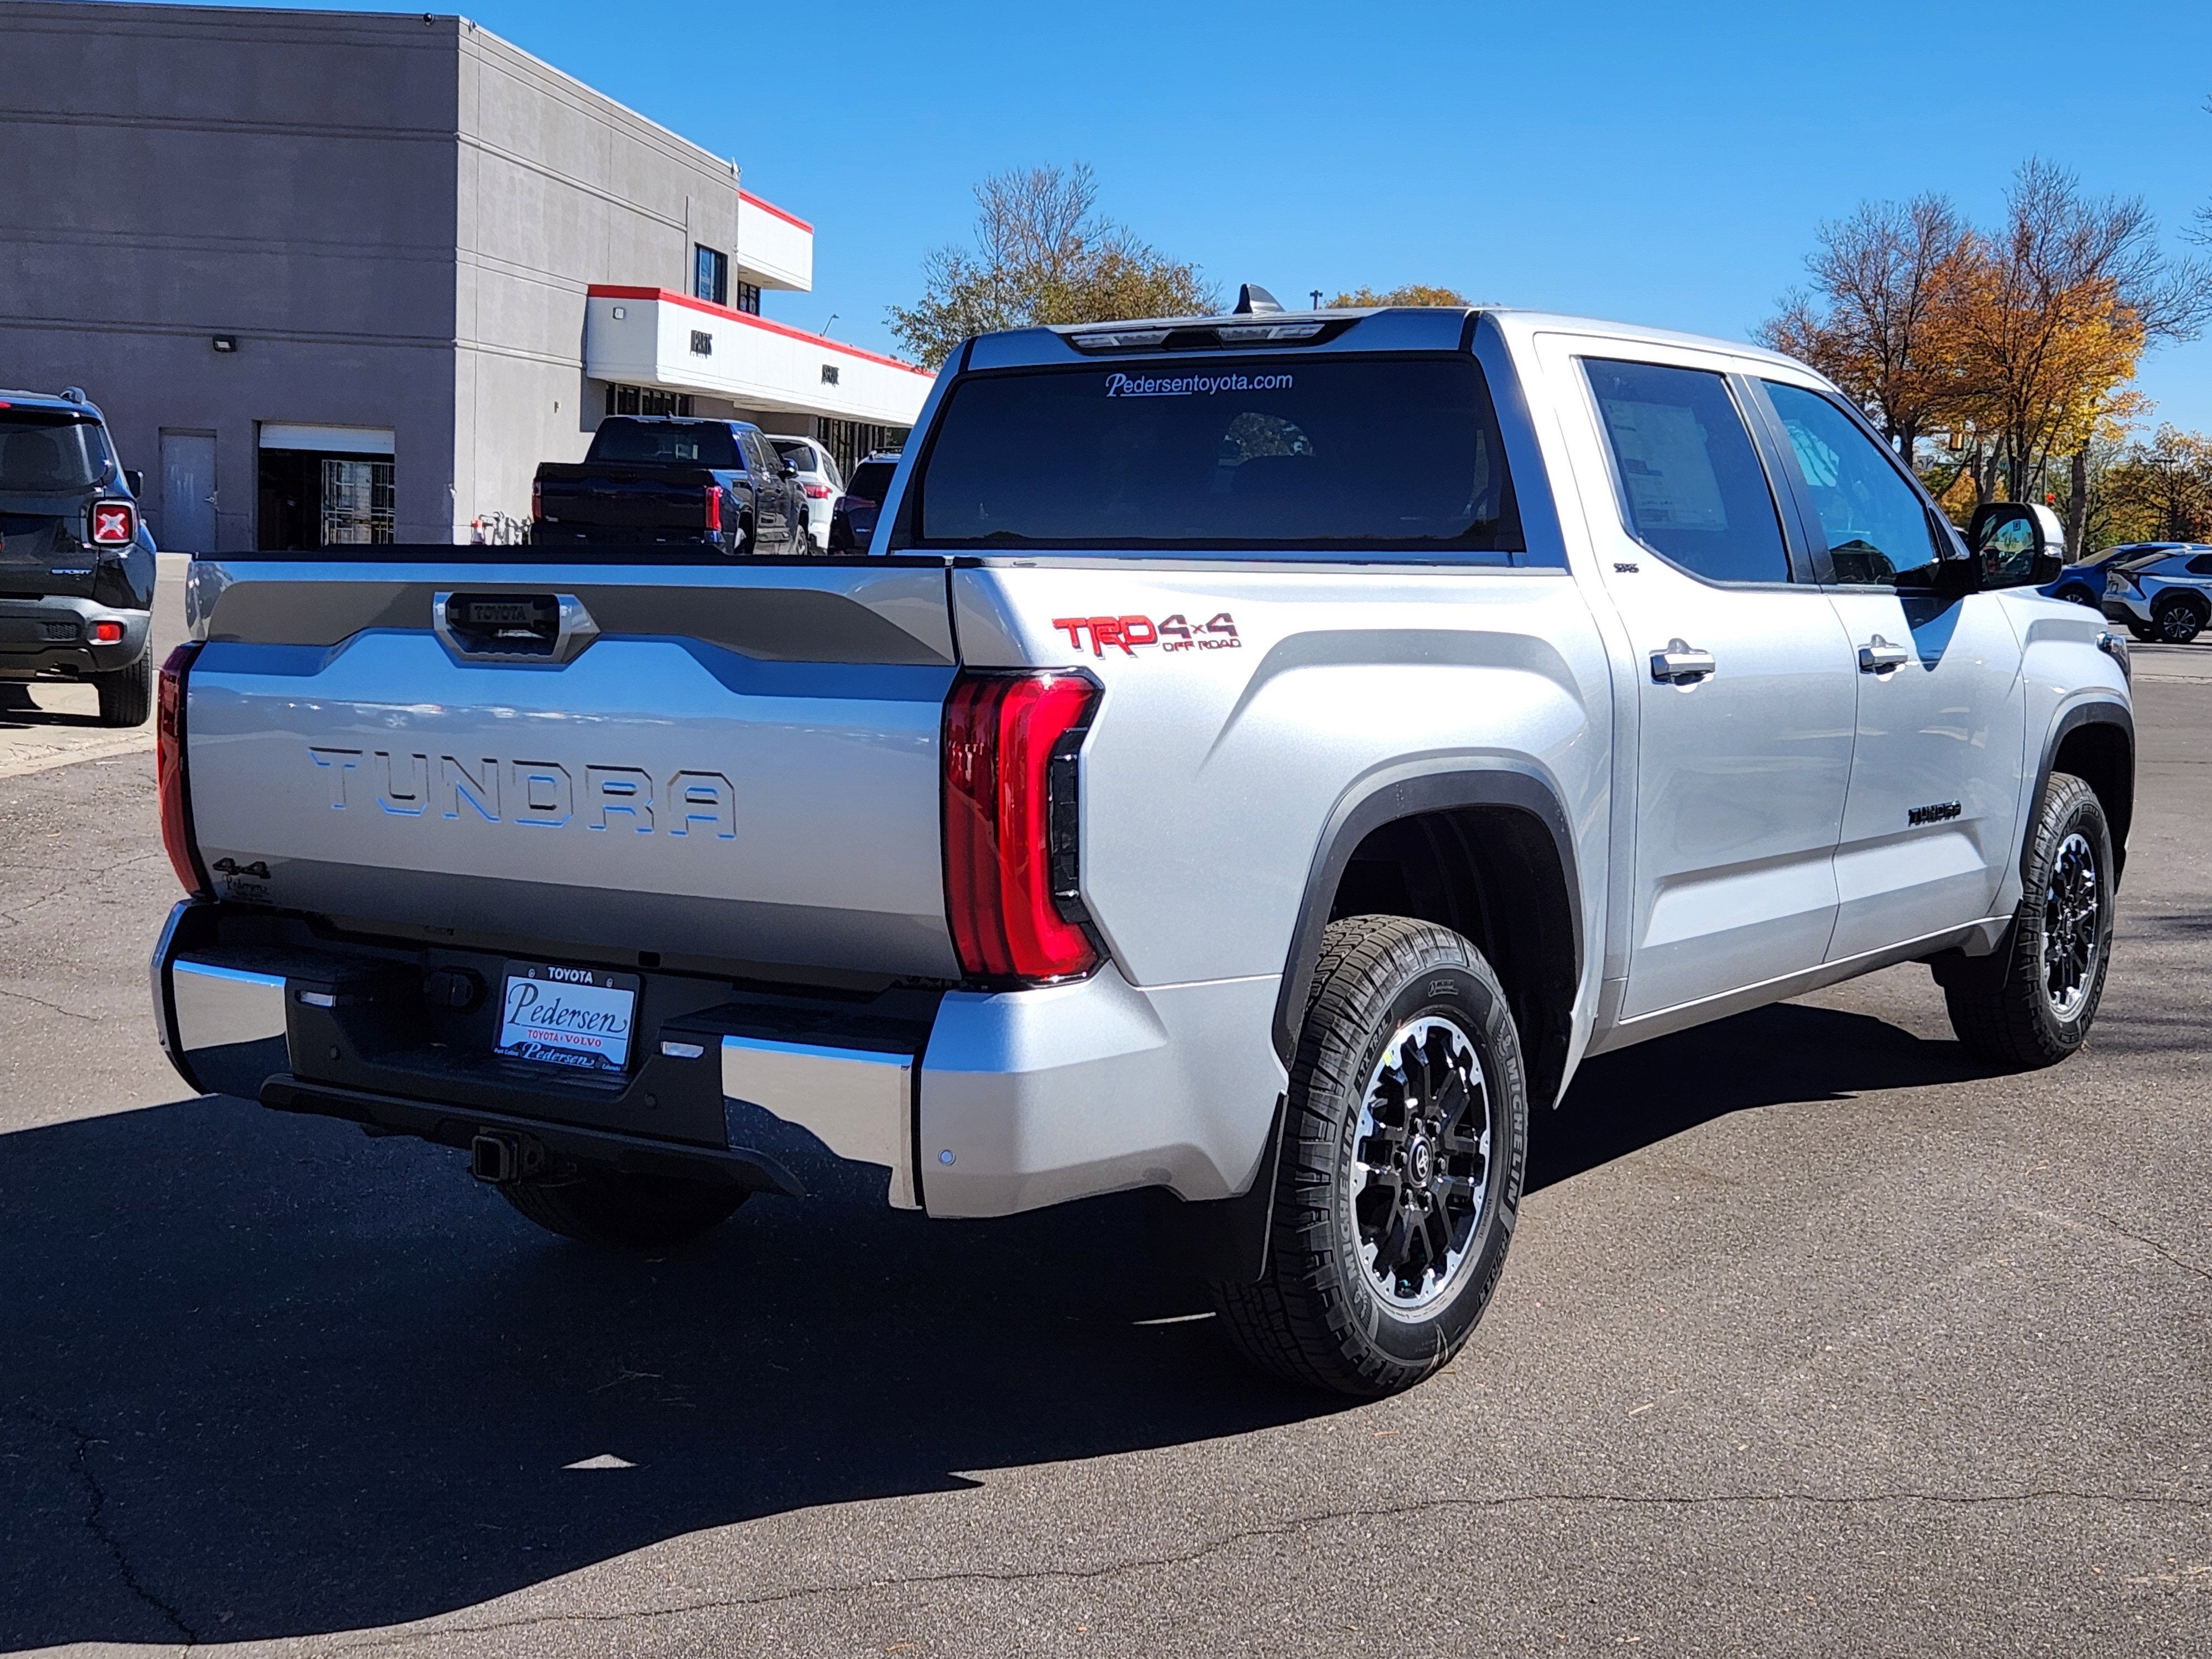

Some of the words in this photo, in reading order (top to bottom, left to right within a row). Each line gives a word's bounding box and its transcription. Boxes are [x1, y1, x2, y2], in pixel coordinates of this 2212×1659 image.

[474, 605, 526, 620] TOYOTA
[1051, 614, 1159, 659] TRD
[1162, 641, 1195, 652] OFF
[1197, 638, 1242, 650] ROAD
[307, 745, 738, 841] TUNDRA
[547, 967, 593, 984] TOYOTA
[507, 982, 628, 1034] Pedersen
[522, 1042, 596, 1066] Pedersen
[528, 1029, 559, 1042] TOYOTA
[565, 1034, 602, 1047] VOLVO
[1357, 1052, 1370, 1084] LTX
[1369, 1018, 1389, 1053] TRAIL
[1506, 1056, 1522, 1206] MICHELIN
[1339, 1116, 1358, 1283] MICHELIN
